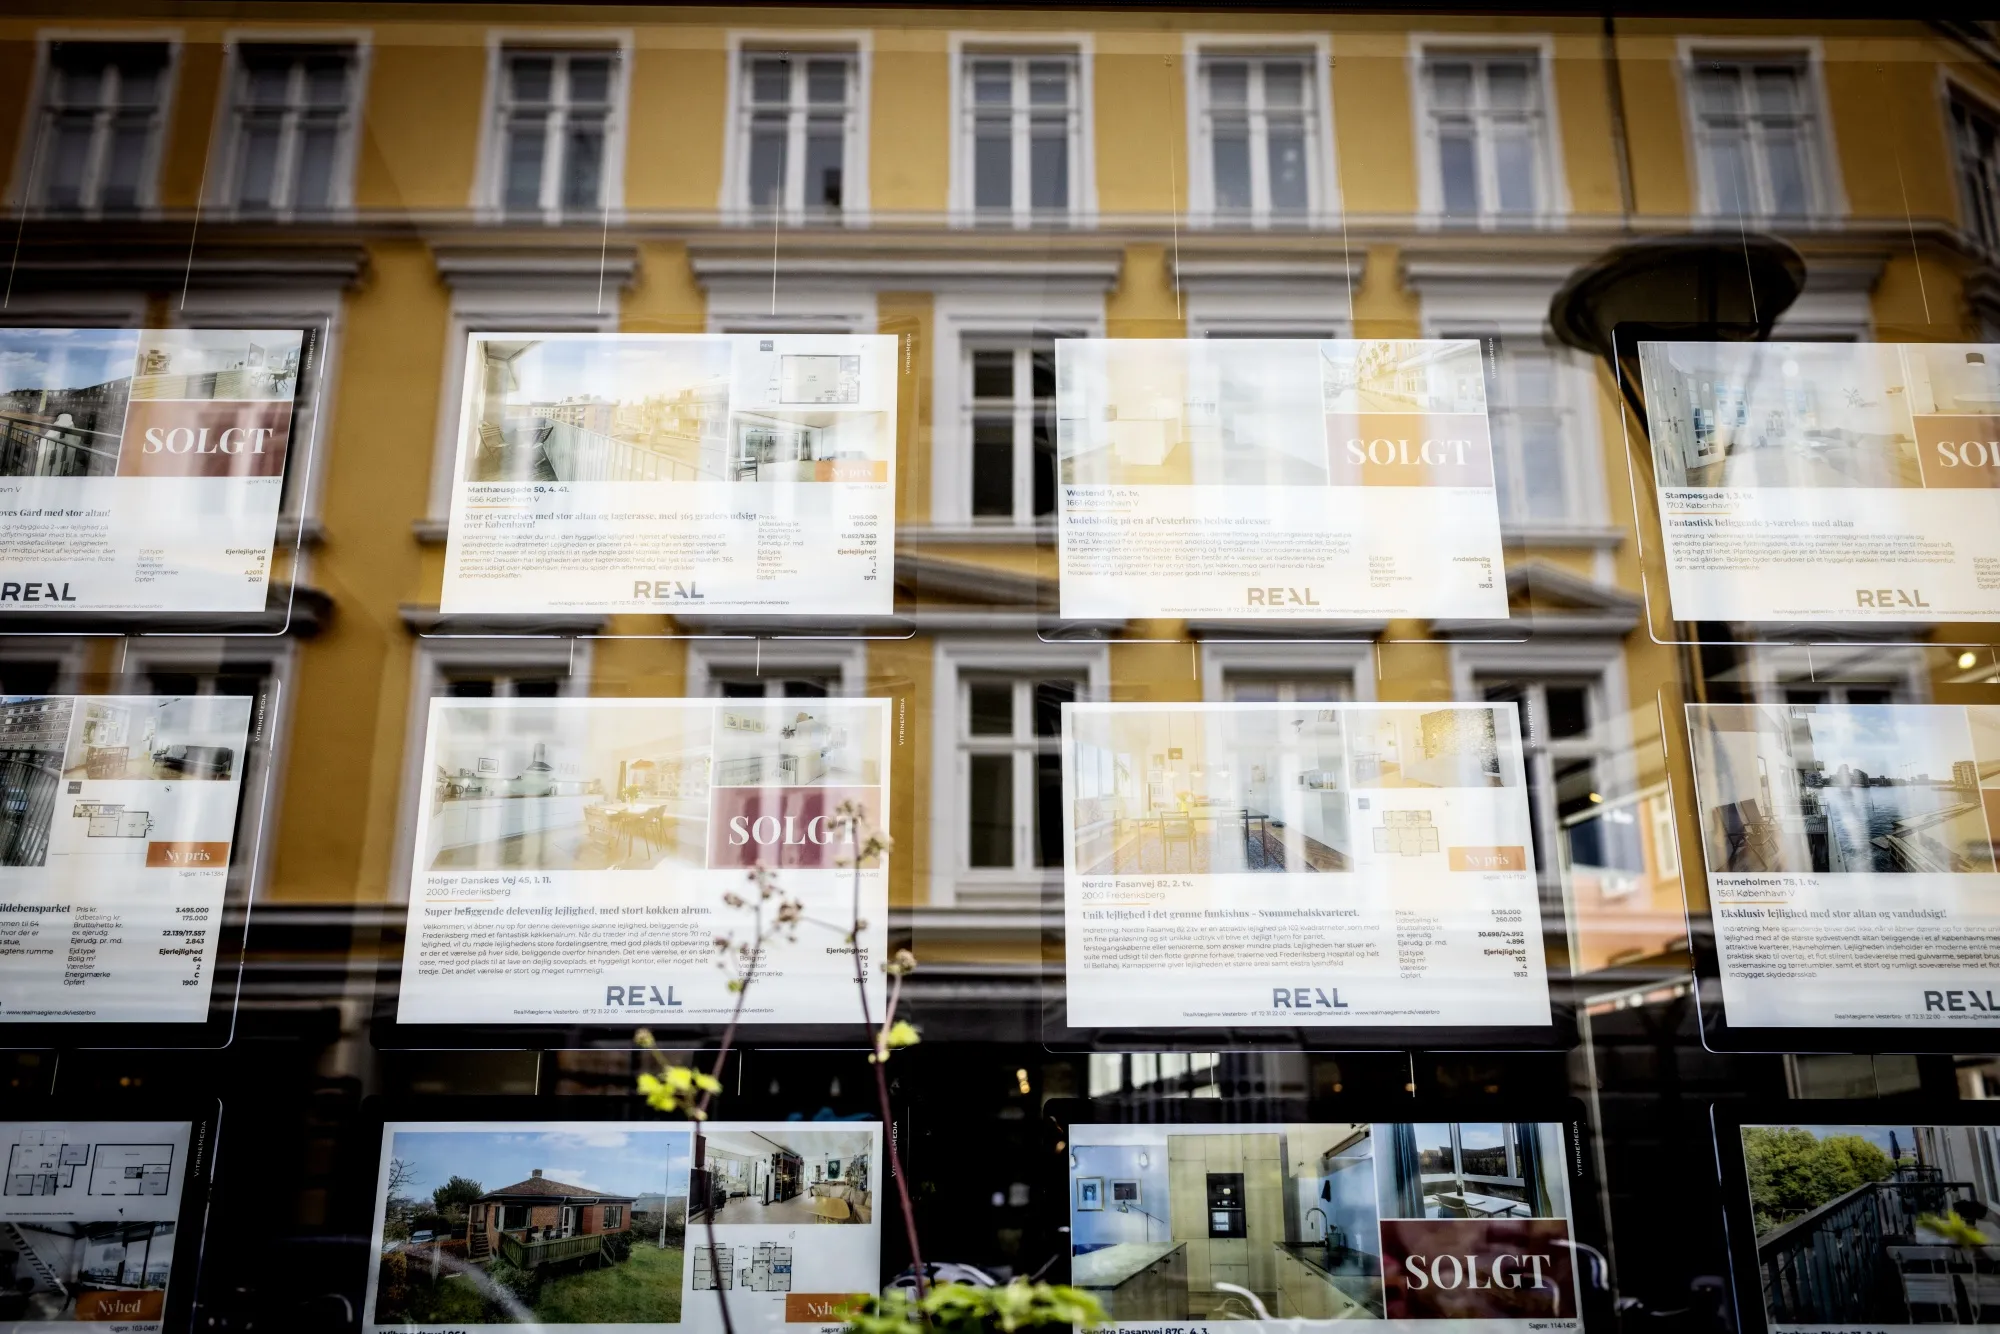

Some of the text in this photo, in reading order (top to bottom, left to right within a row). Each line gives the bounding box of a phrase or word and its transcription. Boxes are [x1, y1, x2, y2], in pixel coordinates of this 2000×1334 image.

[143, 427, 273, 454] SOLGT
[1346, 438, 1472, 466] SOLGT
[467, 486, 532, 495] Matthæusgade
[533, 486, 547, 495] 50,
[548, 486, 557, 494] 4.
[1066, 489, 1105, 497] Westend
[1665, 492, 1725, 501] Stampesgade
[1685, 501, 1734, 509] København
[44, 508, 64, 518] med
[65, 509, 84, 518] stor
[85, 509, 111, 518] altan!
[465, 512, 483, 520] Stor
[535, 512, 554, 520] med
[575, 512, 597, 520] altan
[658, 512, 677, 520] med
[730, 511, 757, 521] udsigt
[1066, 516, 1118, 526] Andelsbolig
[1668, 518, 1714, 527] Fantastisk
[1715, 518, 1763, 528] beliggende
[1812, 518, 1831, 527] med
[1832, 518, 1855, 528] altan
[1, 583, 77, 602] REAL
[633, 580, 705, 599] REAL
[1247, 587, 1320, 606] REAL
[1856, 589, 1930, 608] REAL
[728, 815, 862, 845] SOLGT
[164, 848, 211, 863] Ny pris
[1483, 852, 1510, 868] pris
[428, 876, 459, 885] Holger
[461, 876, 500, 884] Danskes
[502, 876, 516, 886] Vej
[518, 876, 532, 885] 45,
[1082, 880, 1113, 888] Nordre
[1115, 880, 1155, 889] Fasanvej
[1716, 877, 1781, 886] Havneholmen
[426, 887, 511, 897] 2000 Frederiksberg
[1082, 890, 1166, 900] 2000 Frederiksberg
[1736, 889, 1787, 897] København
[424, 906, 453, 917] Super
[454, 906, 504, 917] beliggende
[506, 906, 553, 917] delevenlig
[599, 906, 620, 915] med
[621, 907, 643, 915] stort
[681, 906, 712, 915] alrum.
[1082, 909, 1105, 919] Unik
[1106, 909, 1146, 921] lejlighed
[1153, 909, 1168, 919] det
[1204, 908, 1250, 919] funkishus
[1720, 908, 1948, 920] Eksklusiv lejlighed med stor altan og vandudsigt!
[74, 914, 112, 922] Udbetaling
[158, 948, 204, 956] Ejerlejlighed
[1483, 948, 1526, 956] Ejerlejlighed
[67, 955, 83, 963] Bolig
[606, 985, 683, 1006] REAL
[1273, 987, 1349, 1008] REAL
[1923, 990, 2000, 1012] REAL
[1573, 1120, 1584, 1177] VITRINEMEDIA
[1405, 1254, 1551, 1290] SOLGT
[97, 1299, 142, 1316] Nyhed
[109, 1324, 130, 1333] Sagsnr.
[1528, 1322, 1550, 1330] Sagsnr.
